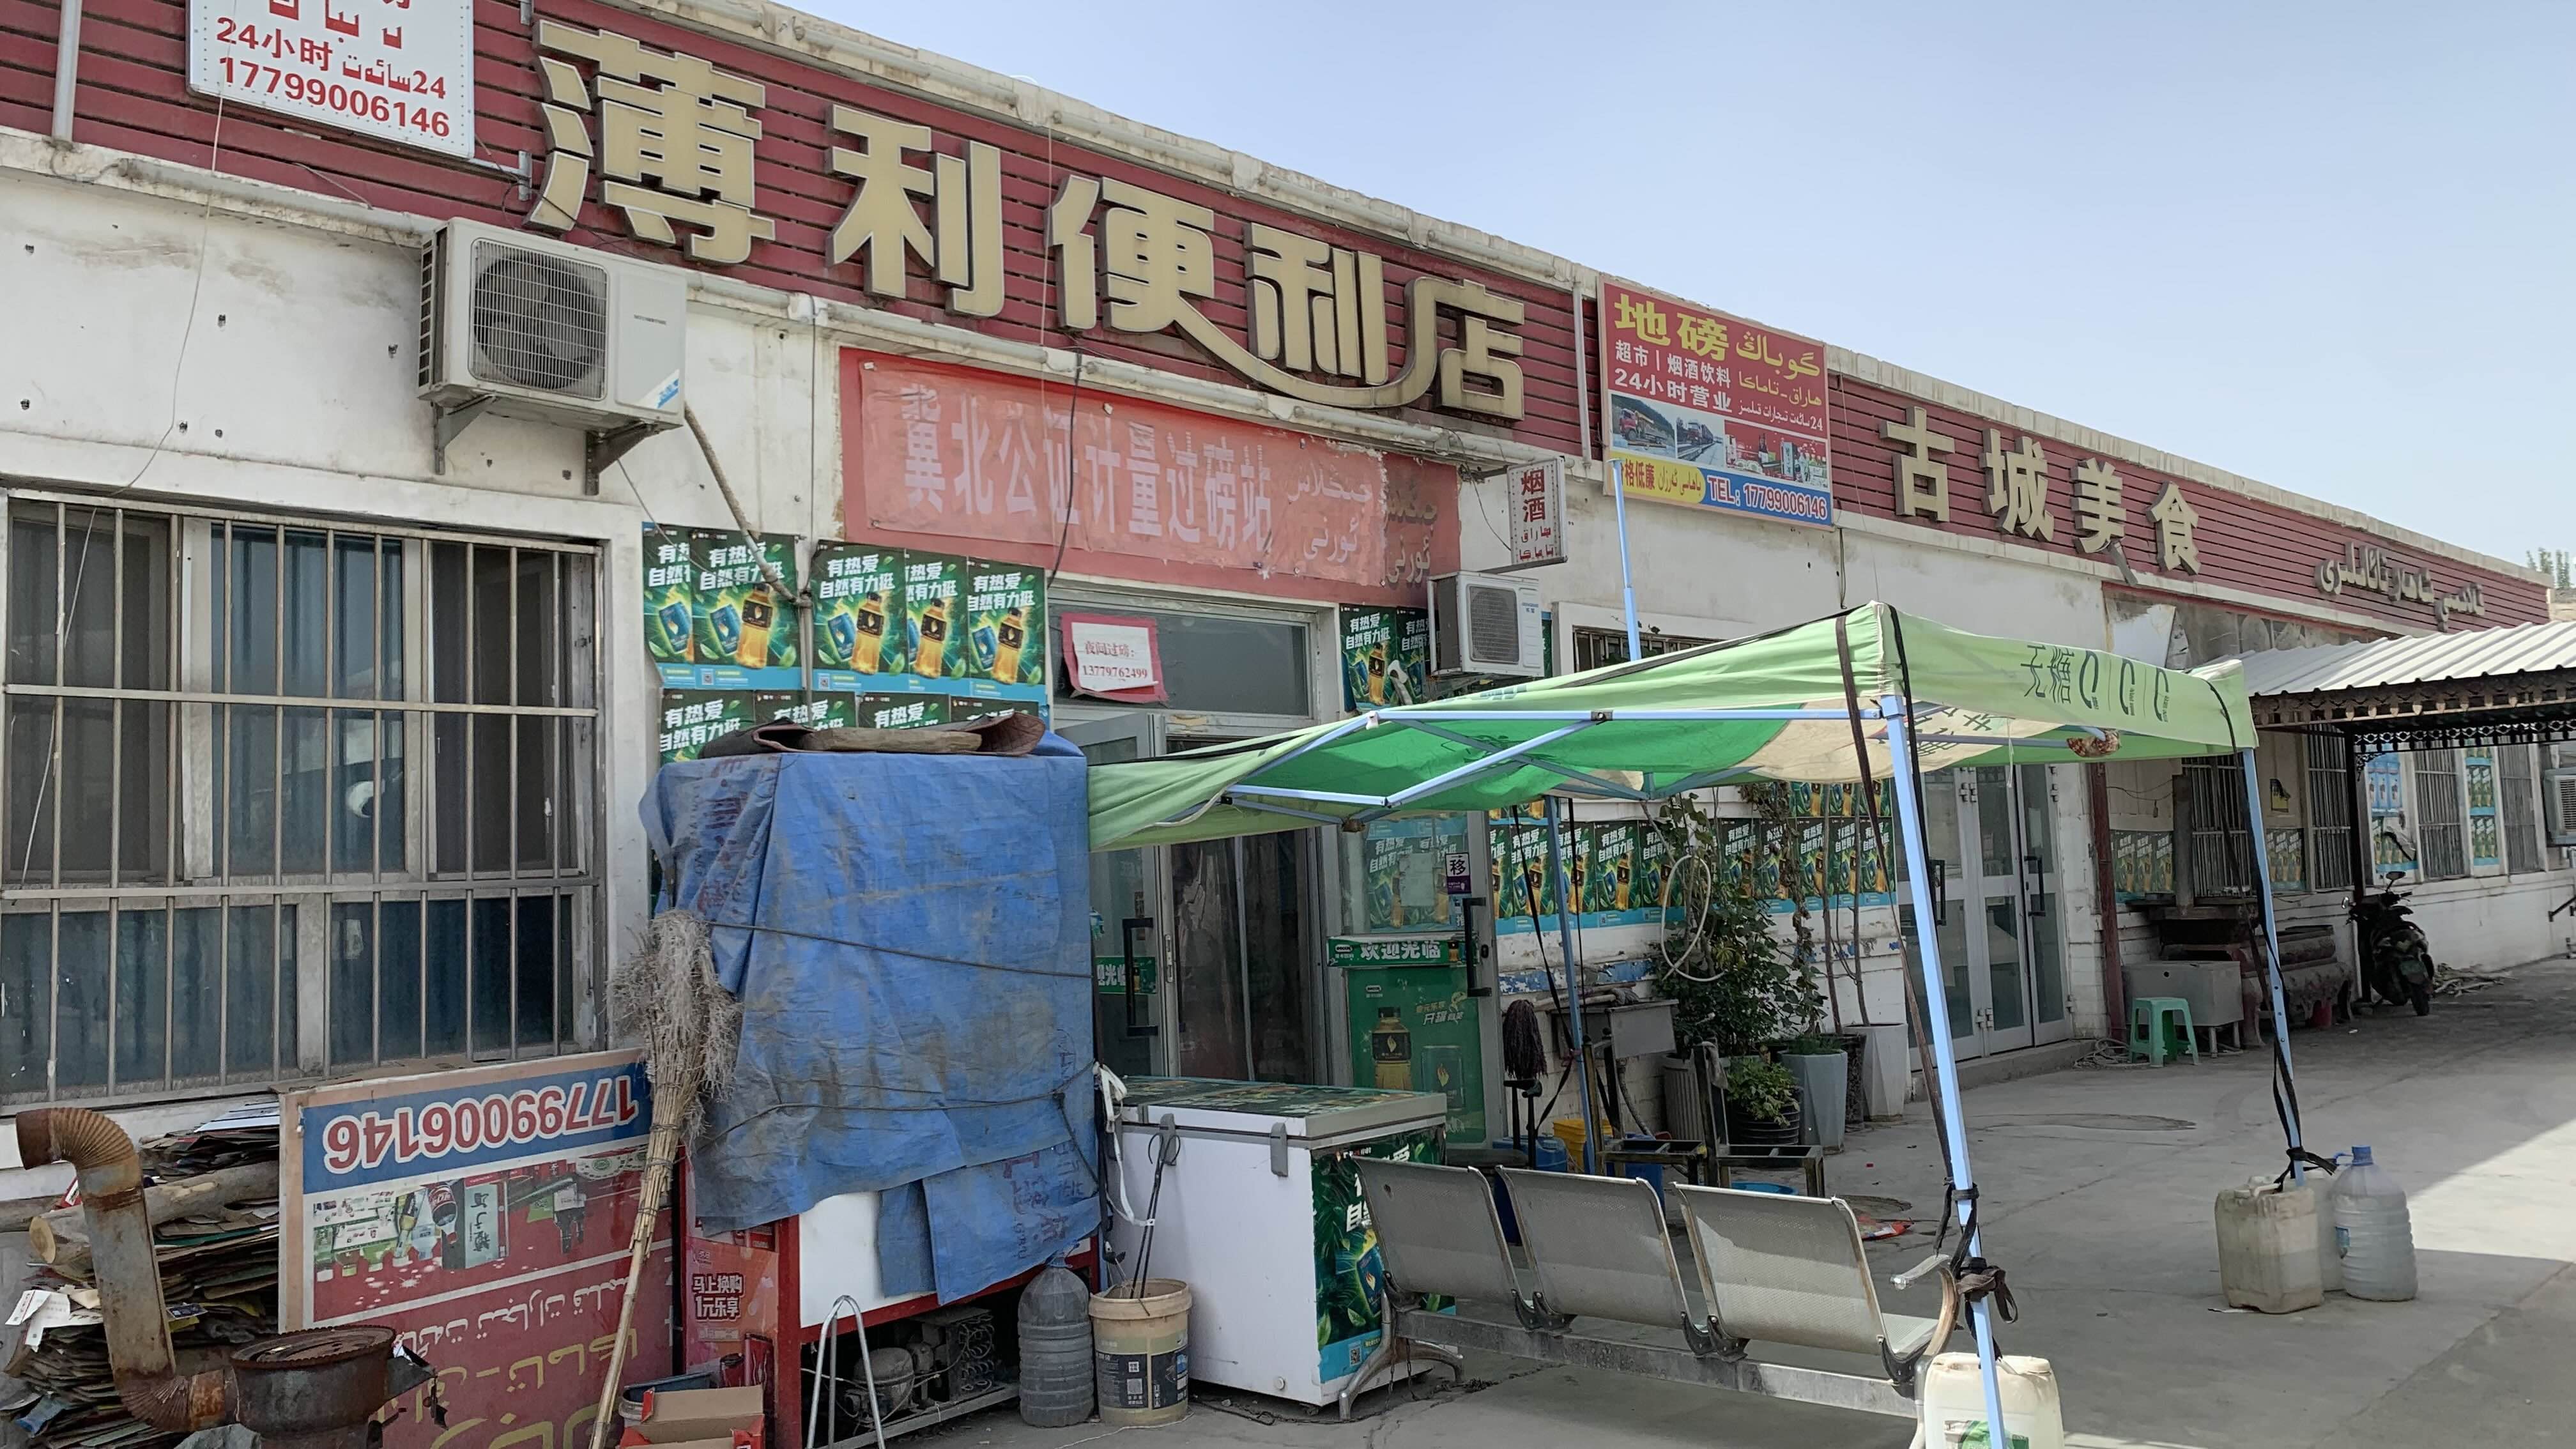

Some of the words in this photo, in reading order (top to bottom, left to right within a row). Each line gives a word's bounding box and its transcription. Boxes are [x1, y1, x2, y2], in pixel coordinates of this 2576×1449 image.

[216, 17, 333, 72] 24小时
[219, 57, 450, 137] 17799006146
[1614, 293, 1729, 361] 地磅
[1614, 368, 1732, 413] 24小时营业
[1620, 458, 1655, 490] 格低廉
[1521, 468, 1545, 523] 烟酒
[1743, 483, 1828, 521] 17799006146
[1879, 404, 2202, 578] 古城美食
[827, 553, 879, 578] 有热爱
[819, 572, 896, 599] 自然有力挺
[973, 572, 1022, 592] 有热爱
[967, 590, 1036, 611] 自然有力挺
[1350, 612, 1381, 633] 有热爱
[1346, 627, 1391, 650] 自然有力挺
[664, 698, 724, 729] 有热爱
[874, 701, 924, 729] 有热爱
[1601, 825, 1627, 847] 有热爱
[1450, 859, 1466, 875] 移
[1360, 940, 1441, 960] 欢迎光临
[323, 1077, 638, 1175] 17799006146
[693, 1274, 742, 1294] 马上换购
[695, 1295, 739, 1317] 1元乐享
